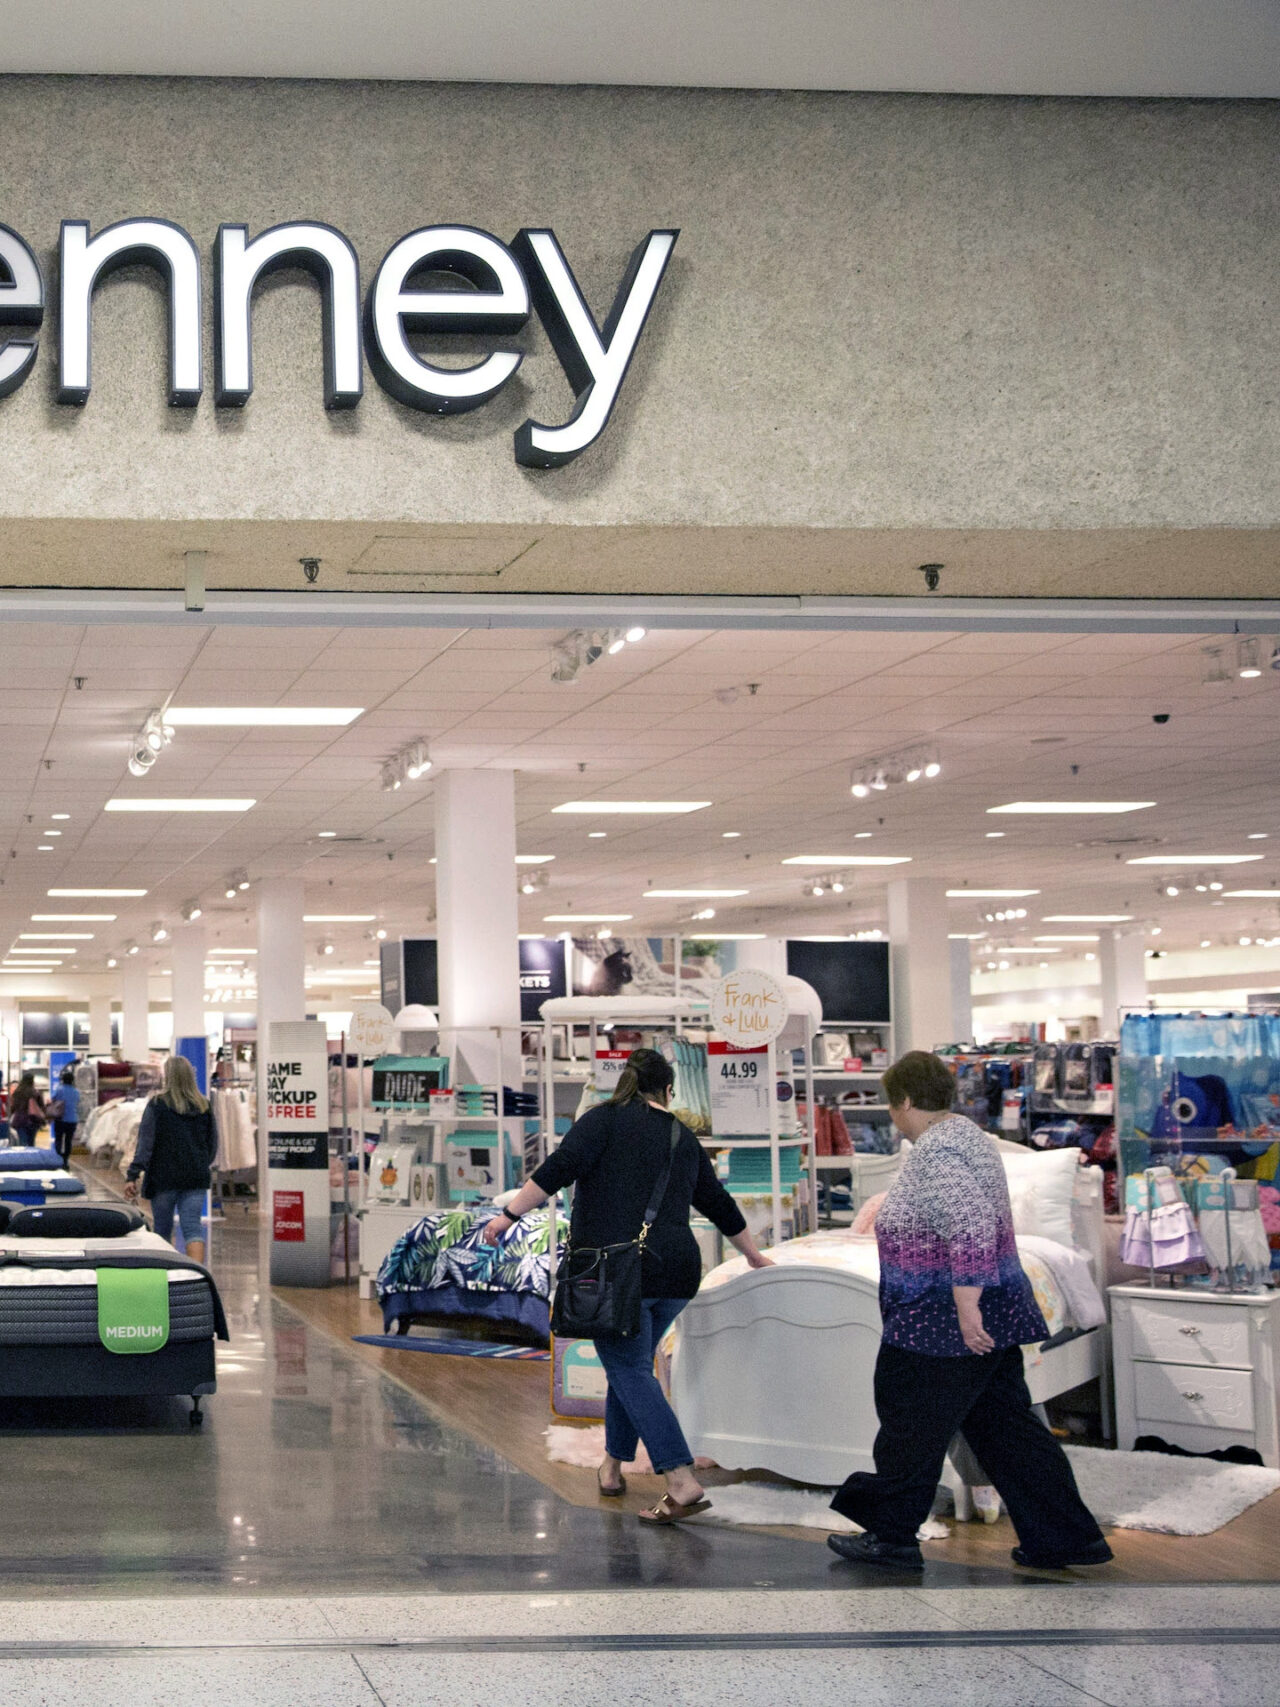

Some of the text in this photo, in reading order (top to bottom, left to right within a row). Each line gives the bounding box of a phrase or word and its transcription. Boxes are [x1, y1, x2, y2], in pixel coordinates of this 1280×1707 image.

[724, 983, 778, 1008] Frank
[720, 1061, 758, 1079] 44.99
[384, 1072, 426, 1101] DUDE
[275, 1105, 317, 1118] FREE
[106, 1326, 163, 1338] MEDIUM
